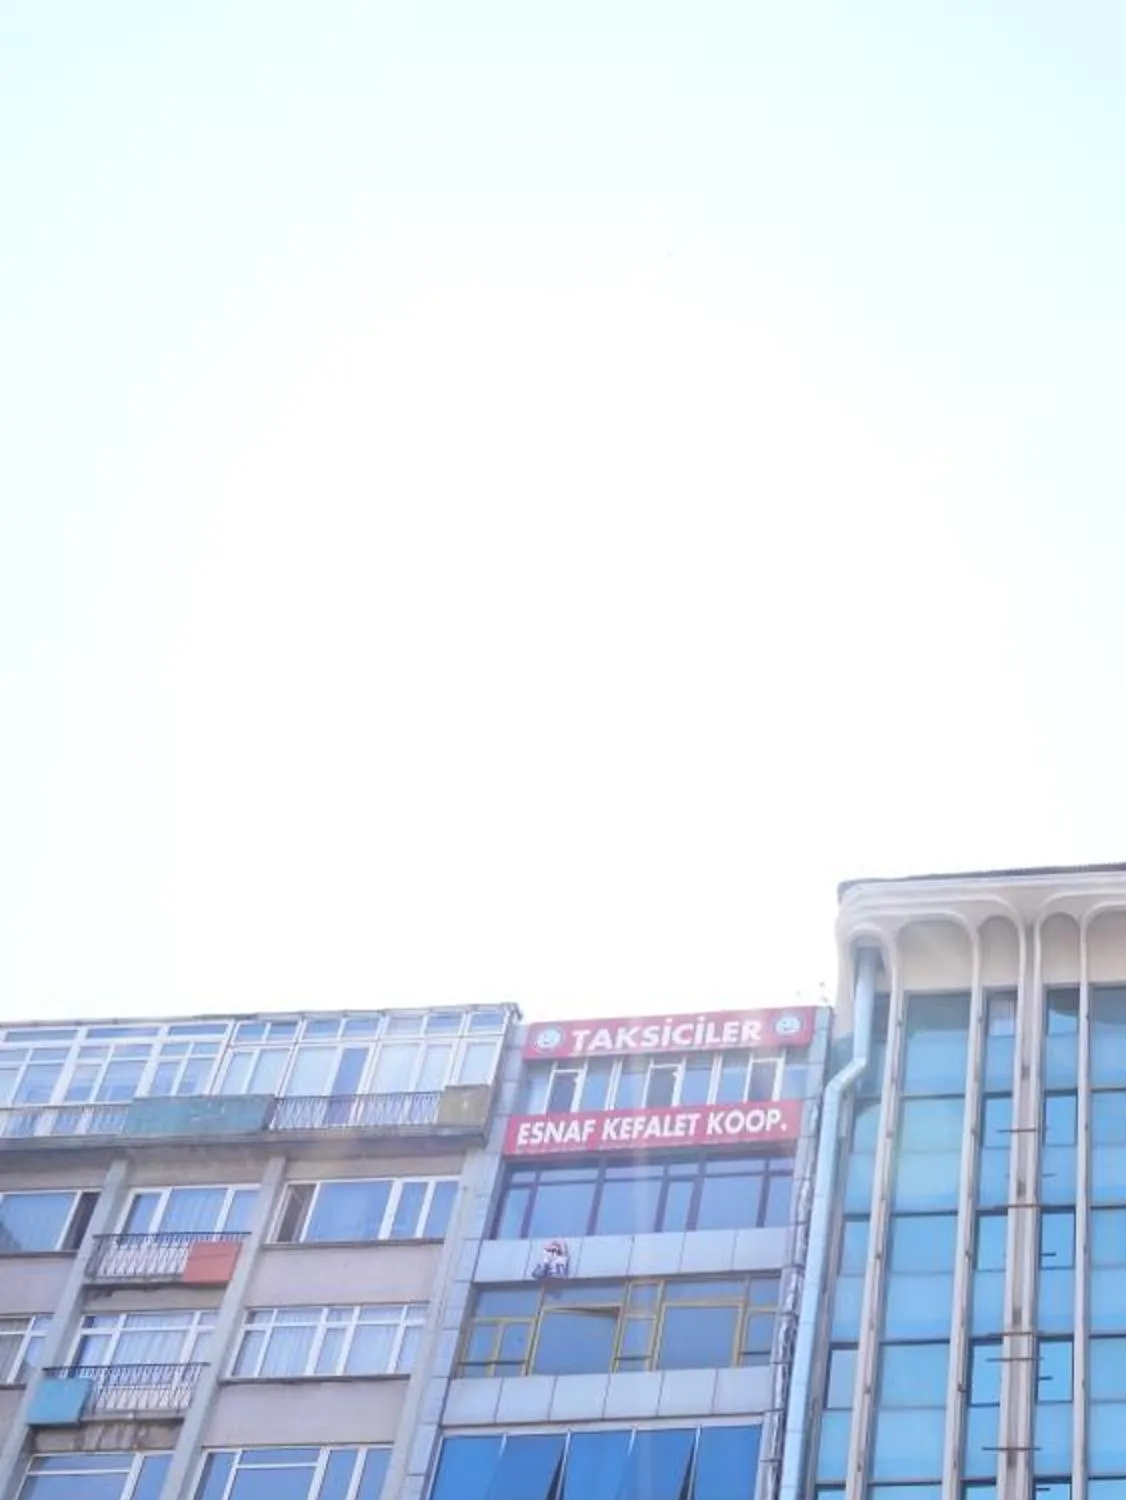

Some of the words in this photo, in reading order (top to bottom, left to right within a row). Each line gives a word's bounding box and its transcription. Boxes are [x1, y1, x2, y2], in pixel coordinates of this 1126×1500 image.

[571, 1016, 762, 1052] TAKSİCİLER
[516, 1118, 596, 1146] ESNAF
[601, 1113, 701, 1141] KEFALET
[706, 1108, 788, 1136] KOOP.
